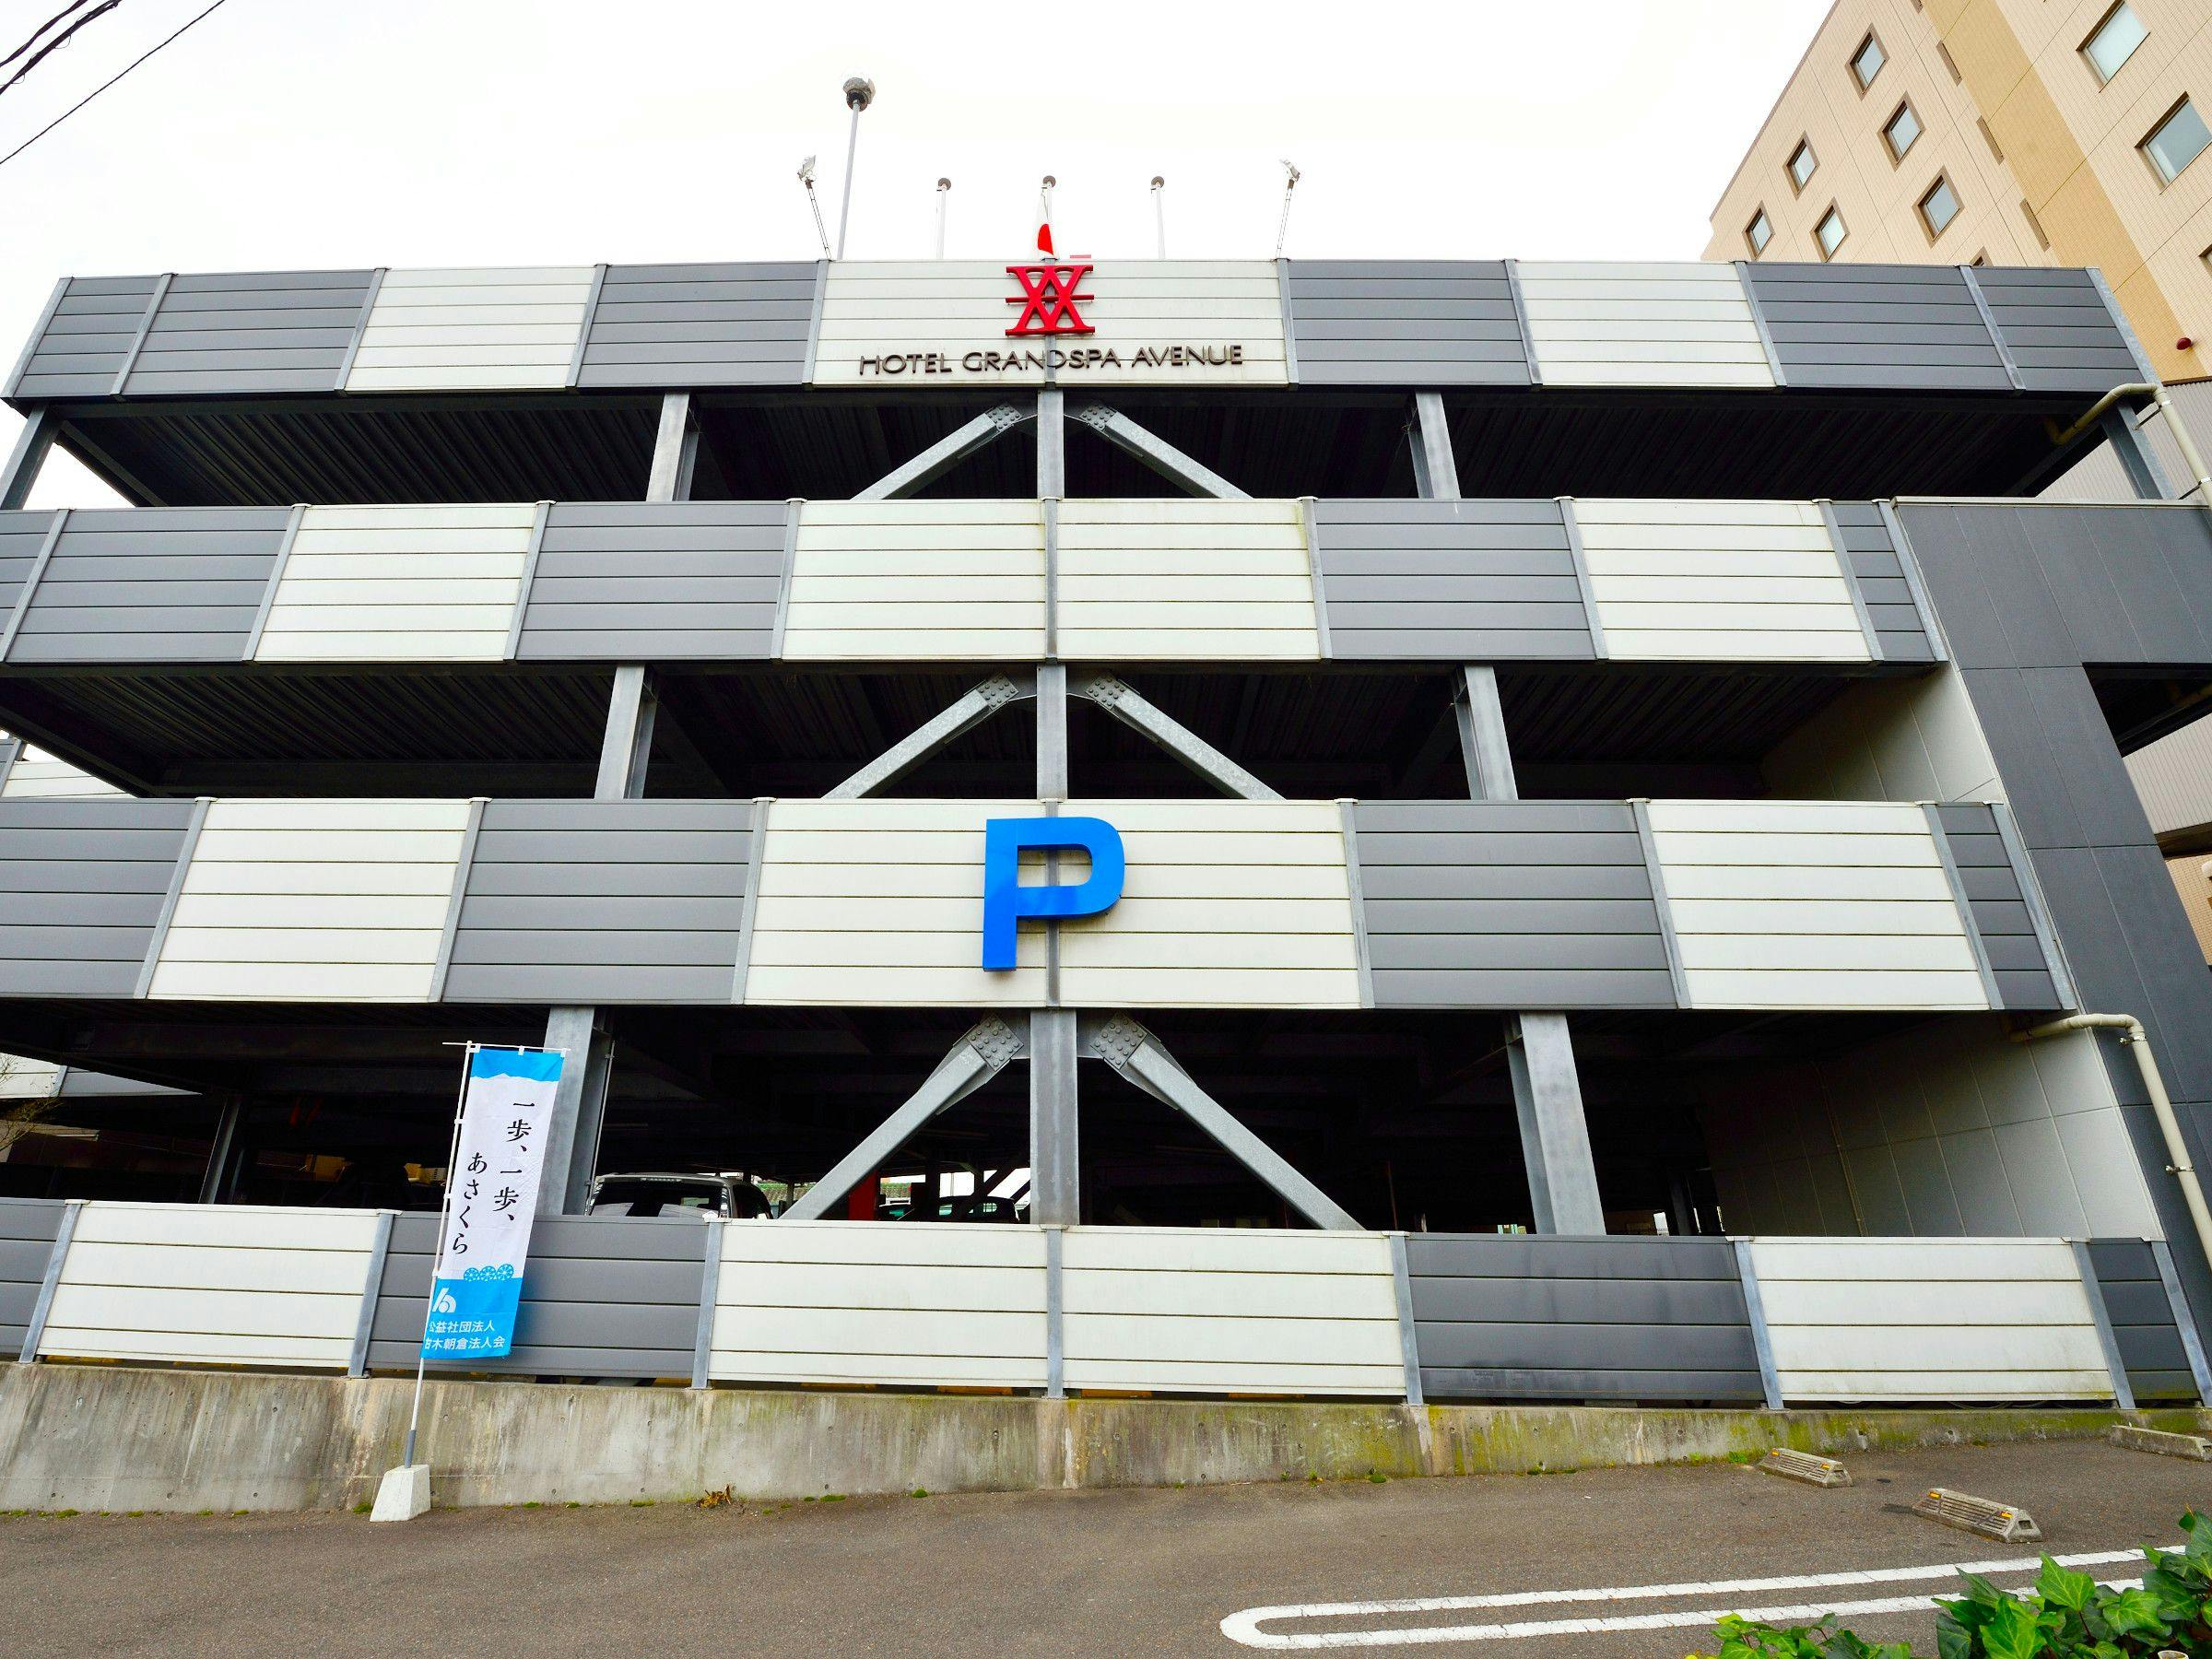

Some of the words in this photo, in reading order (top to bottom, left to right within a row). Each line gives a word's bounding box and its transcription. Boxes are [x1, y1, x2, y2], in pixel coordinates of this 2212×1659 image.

[859, 353, 953, 376] HOTEL
[962, 347, 1122, 372] GRANDSPA
[1131, 345, 1243, 368] AVENUE
[982, 817, 1125, 971] P
[452, 1151, 488, 1255] あさくら
